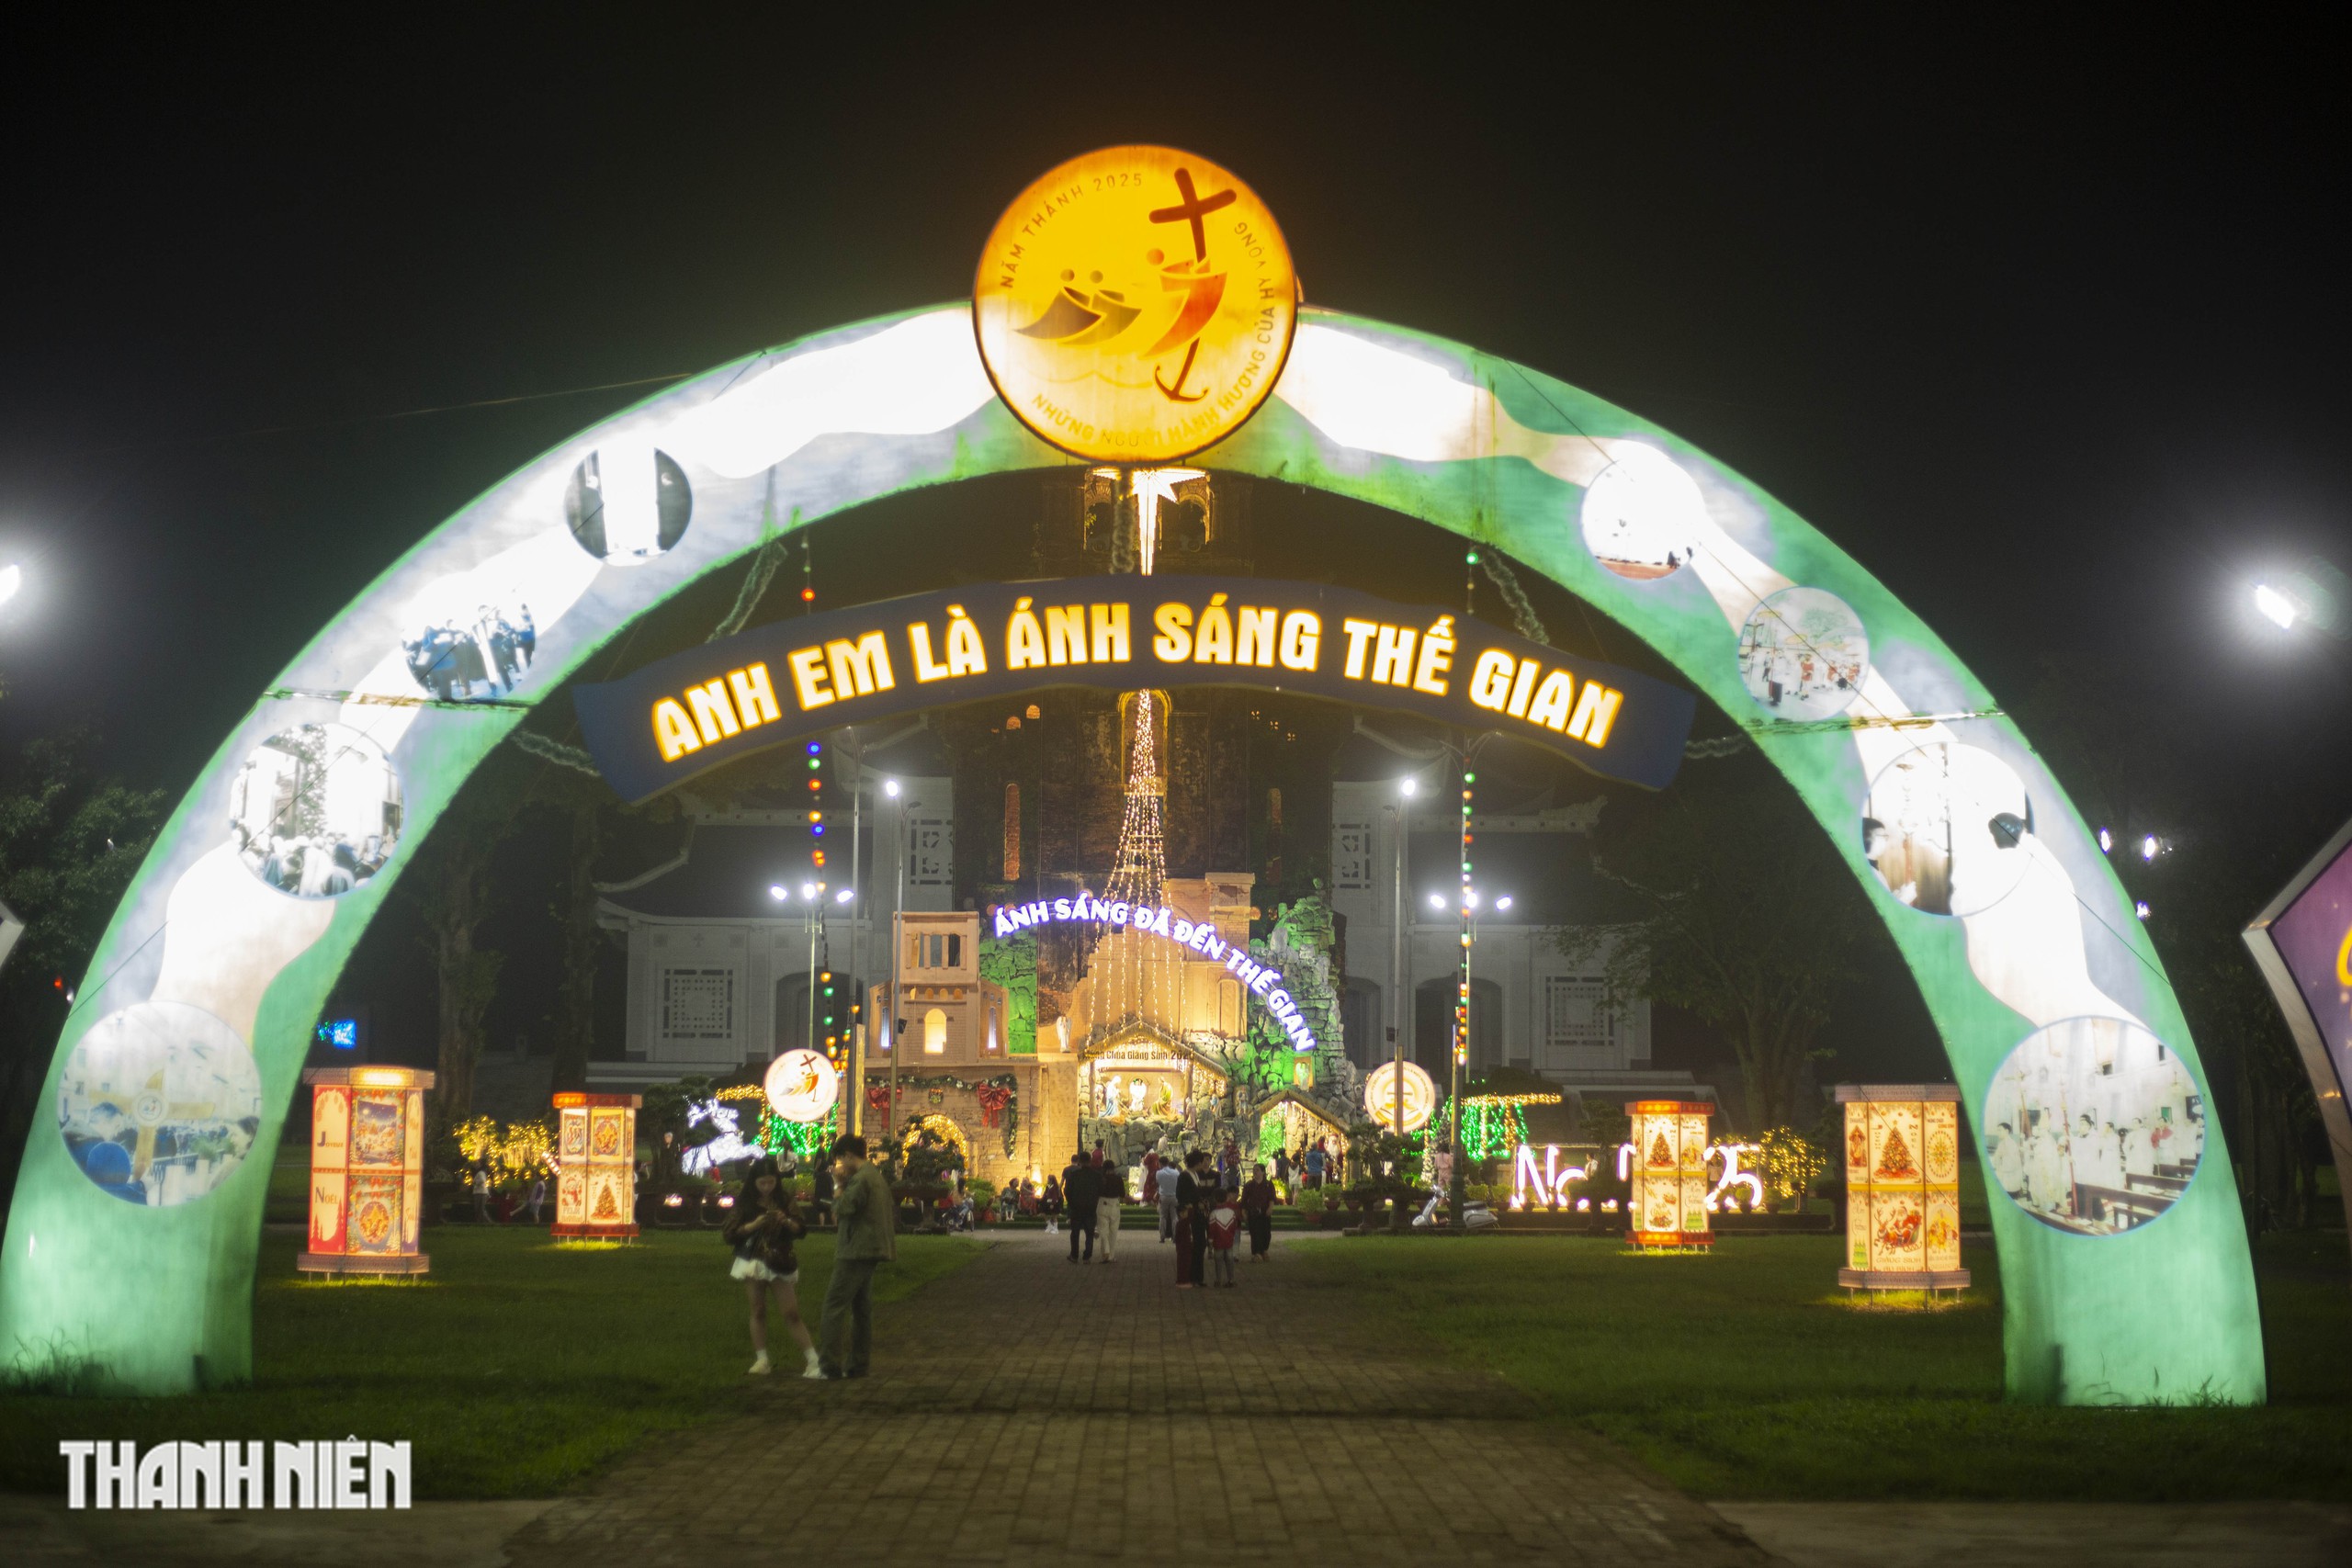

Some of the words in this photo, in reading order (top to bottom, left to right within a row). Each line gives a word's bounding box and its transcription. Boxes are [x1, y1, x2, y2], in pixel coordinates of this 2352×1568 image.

[1000, 243, 1025, 289] NĂM
[1022, 185, 1084, 236] THÁNH
[1093, 173, 1143, 192] 2025
[1253, 306, 1276, 345] CỦA
[1258, 277, 1275, 299] HY
[1032, 393, 1095, 441] NHỮNG
[651, 662, 782, 763] ANH
[787, 629, 896, 712] EM
[908, 604, 988, 684] LÀ
[1006, 597, 1131, 671] ÁNH
[1152, 592, 1321, 671] SÁNG
[1342, 615, 1457, 696] THẾ
[1468, 648, 1623, 750] GIAN
[995, 906, 1050, 938] ÁNH
[1054, 891, 1130, 925] SÁNG
[1134, 906, 1171, 937] ĐÃ
[1172, 919, 1227, 961] ĐẾN
[1227, 948, 1282, 994] THẾ
[1268, 988, 1317, 1052] GIAN
